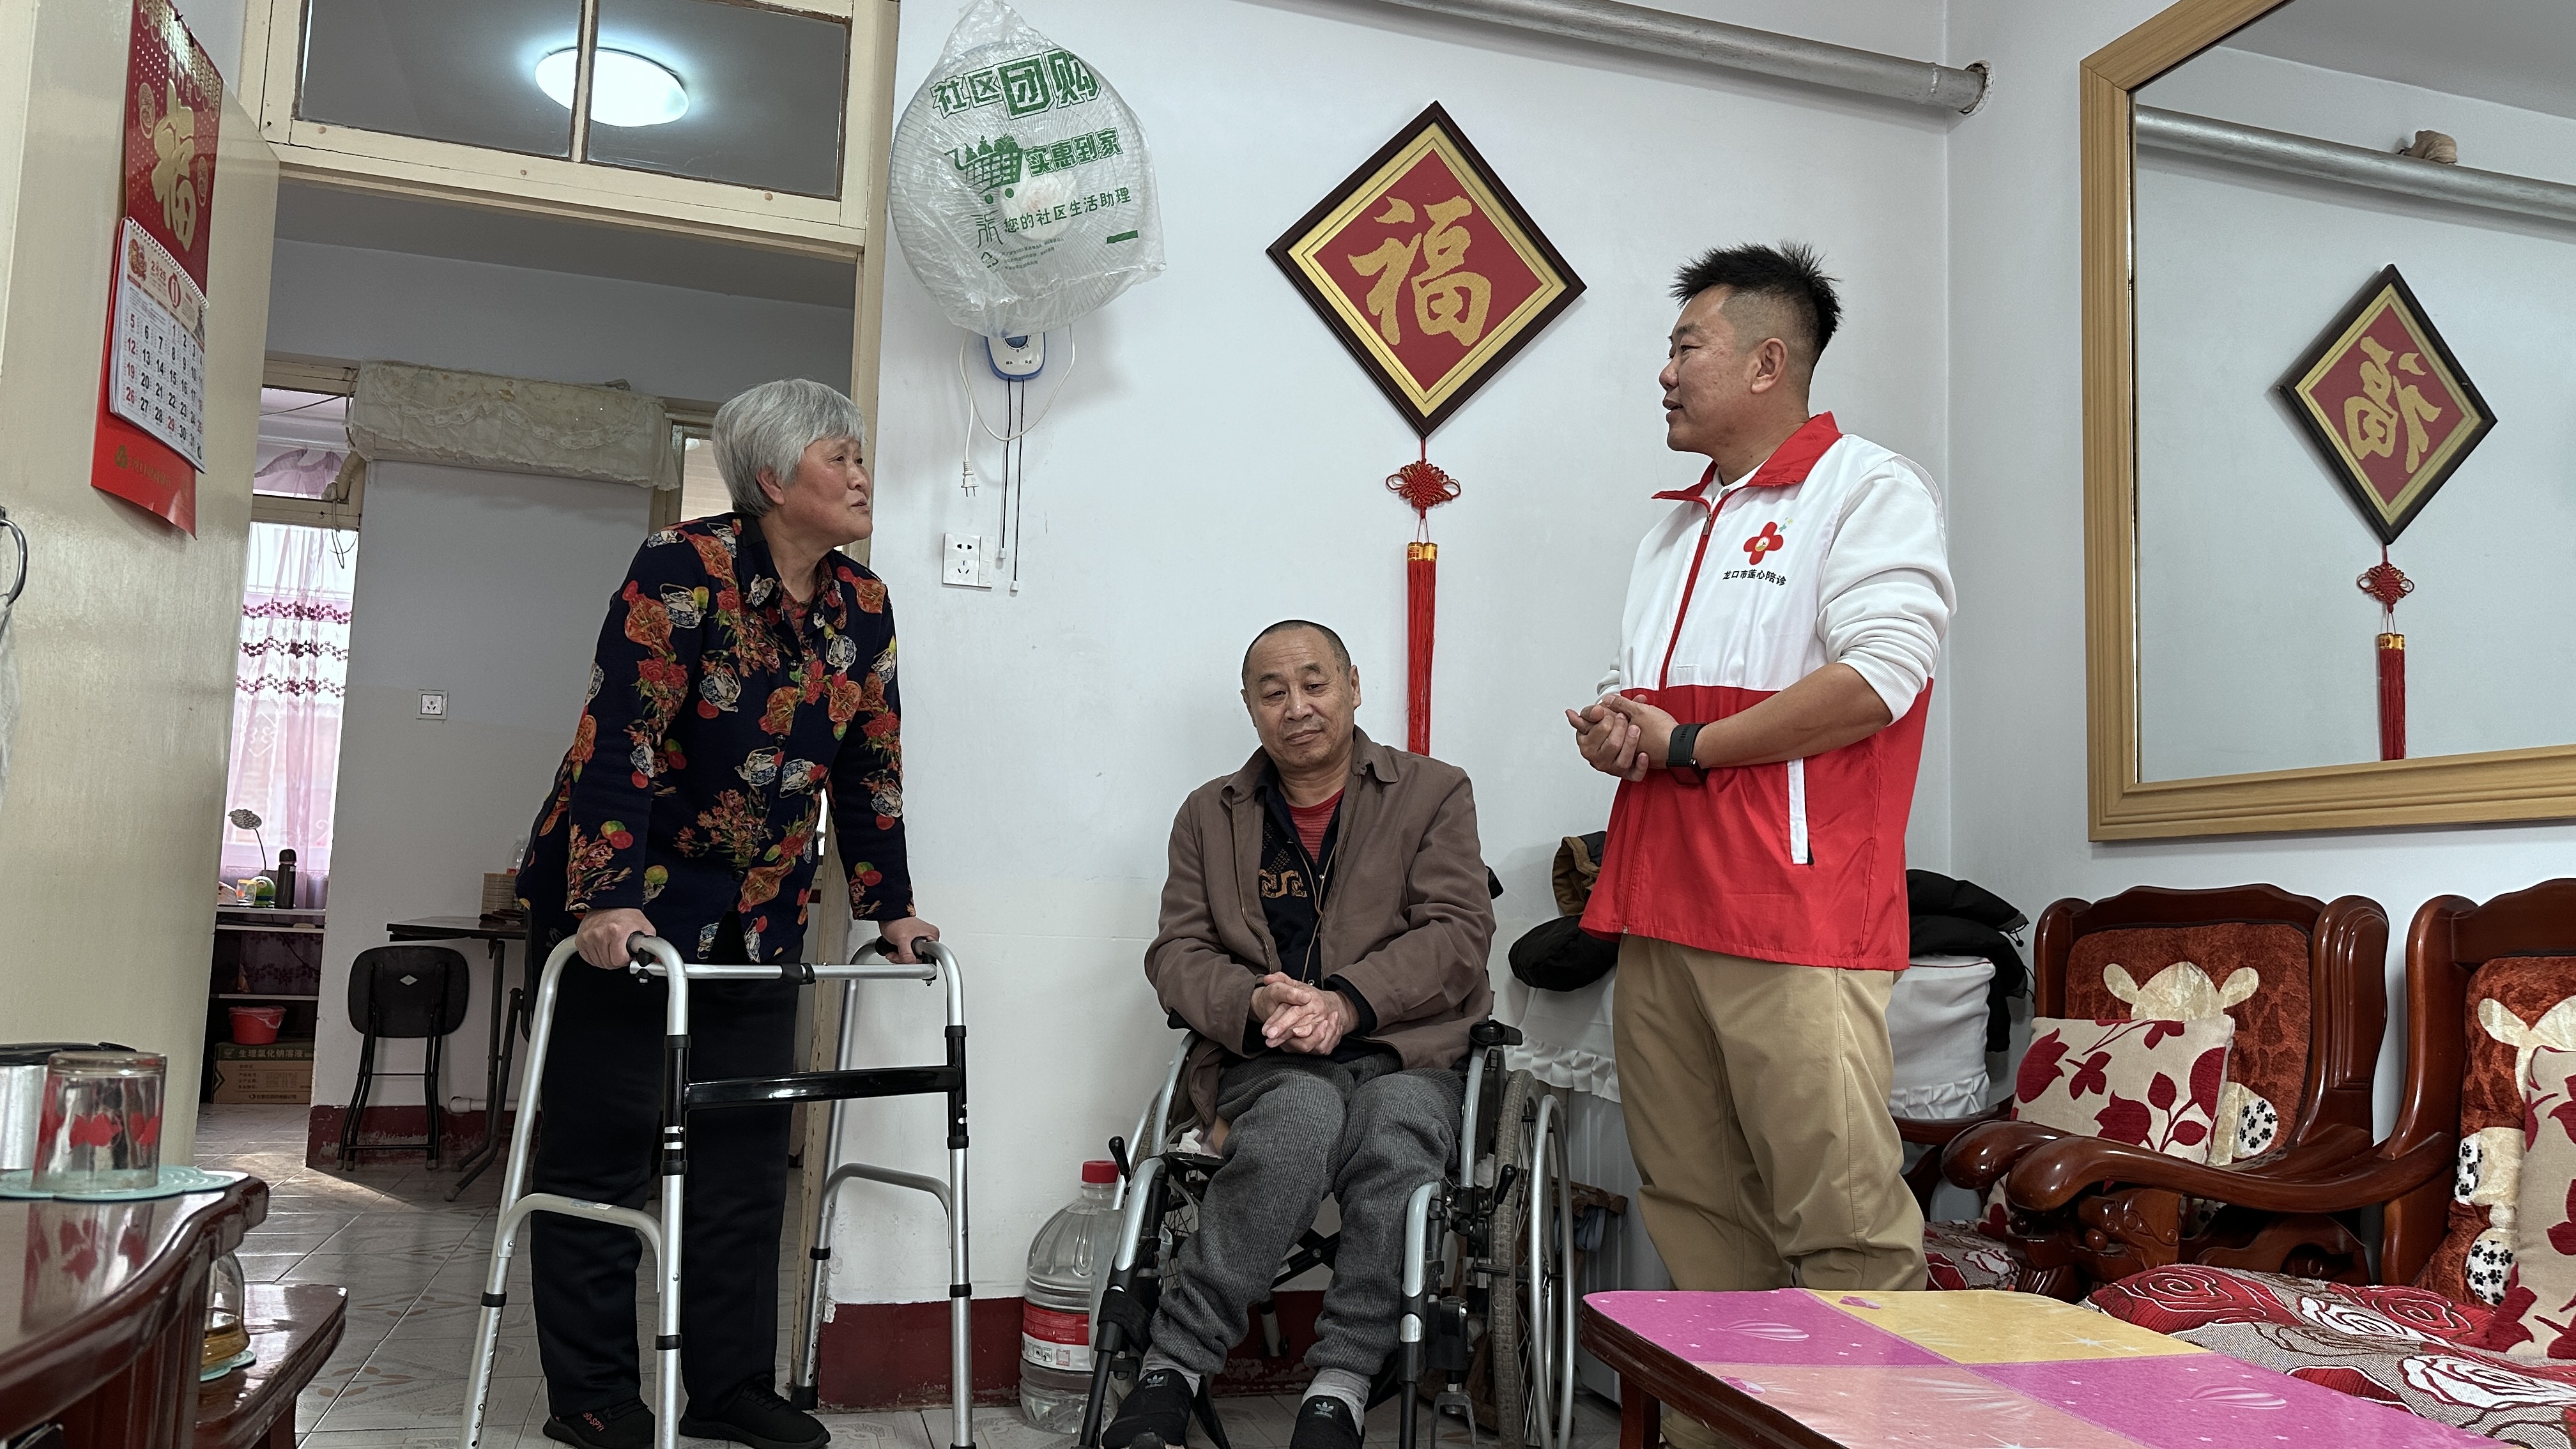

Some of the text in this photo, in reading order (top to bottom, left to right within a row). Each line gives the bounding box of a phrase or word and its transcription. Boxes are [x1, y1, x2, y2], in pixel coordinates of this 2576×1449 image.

[930, 48, 1101, 120] 社区团购
[1023, 127, 1123, 177] 实惠到家
[1003, 187, 1131, 233] 您的社区生活助理
[1347, 195, 1492, 347] 福
[130, 314, 135, 328] 5
[144, 325, 149, 340] 6
[158, 336, 164, 350] 7
[172, 347, 176, 360] 8
[183, 357, 187, 371] 9
[183, 334, 187, 348] 2
[126, 362, 135, 379] 19
[141, 372, 150, 390] 20
[156, 382, 163, 399] 21
[168, 392, 176, 409] 22
[180, 401, 187, 418] 23
[127, 337, 135, 355] 12
[142, 348, 151, 366] 13
[157, 359, 164, 376] 14
[169, 369, 177, 385] 15
[181, 379, 188, 395] 16
[190, 388, 196, 404] 17
[126, 387, 135, 404] 26
[140, 396, 149, 413] 27
[155, 406, 163, 424] 28
[167, 416, 175, 432] 29
[179, 424, 187, 441] 30
[238, 1048, 303, 1059] 生理氯化钠溶液
